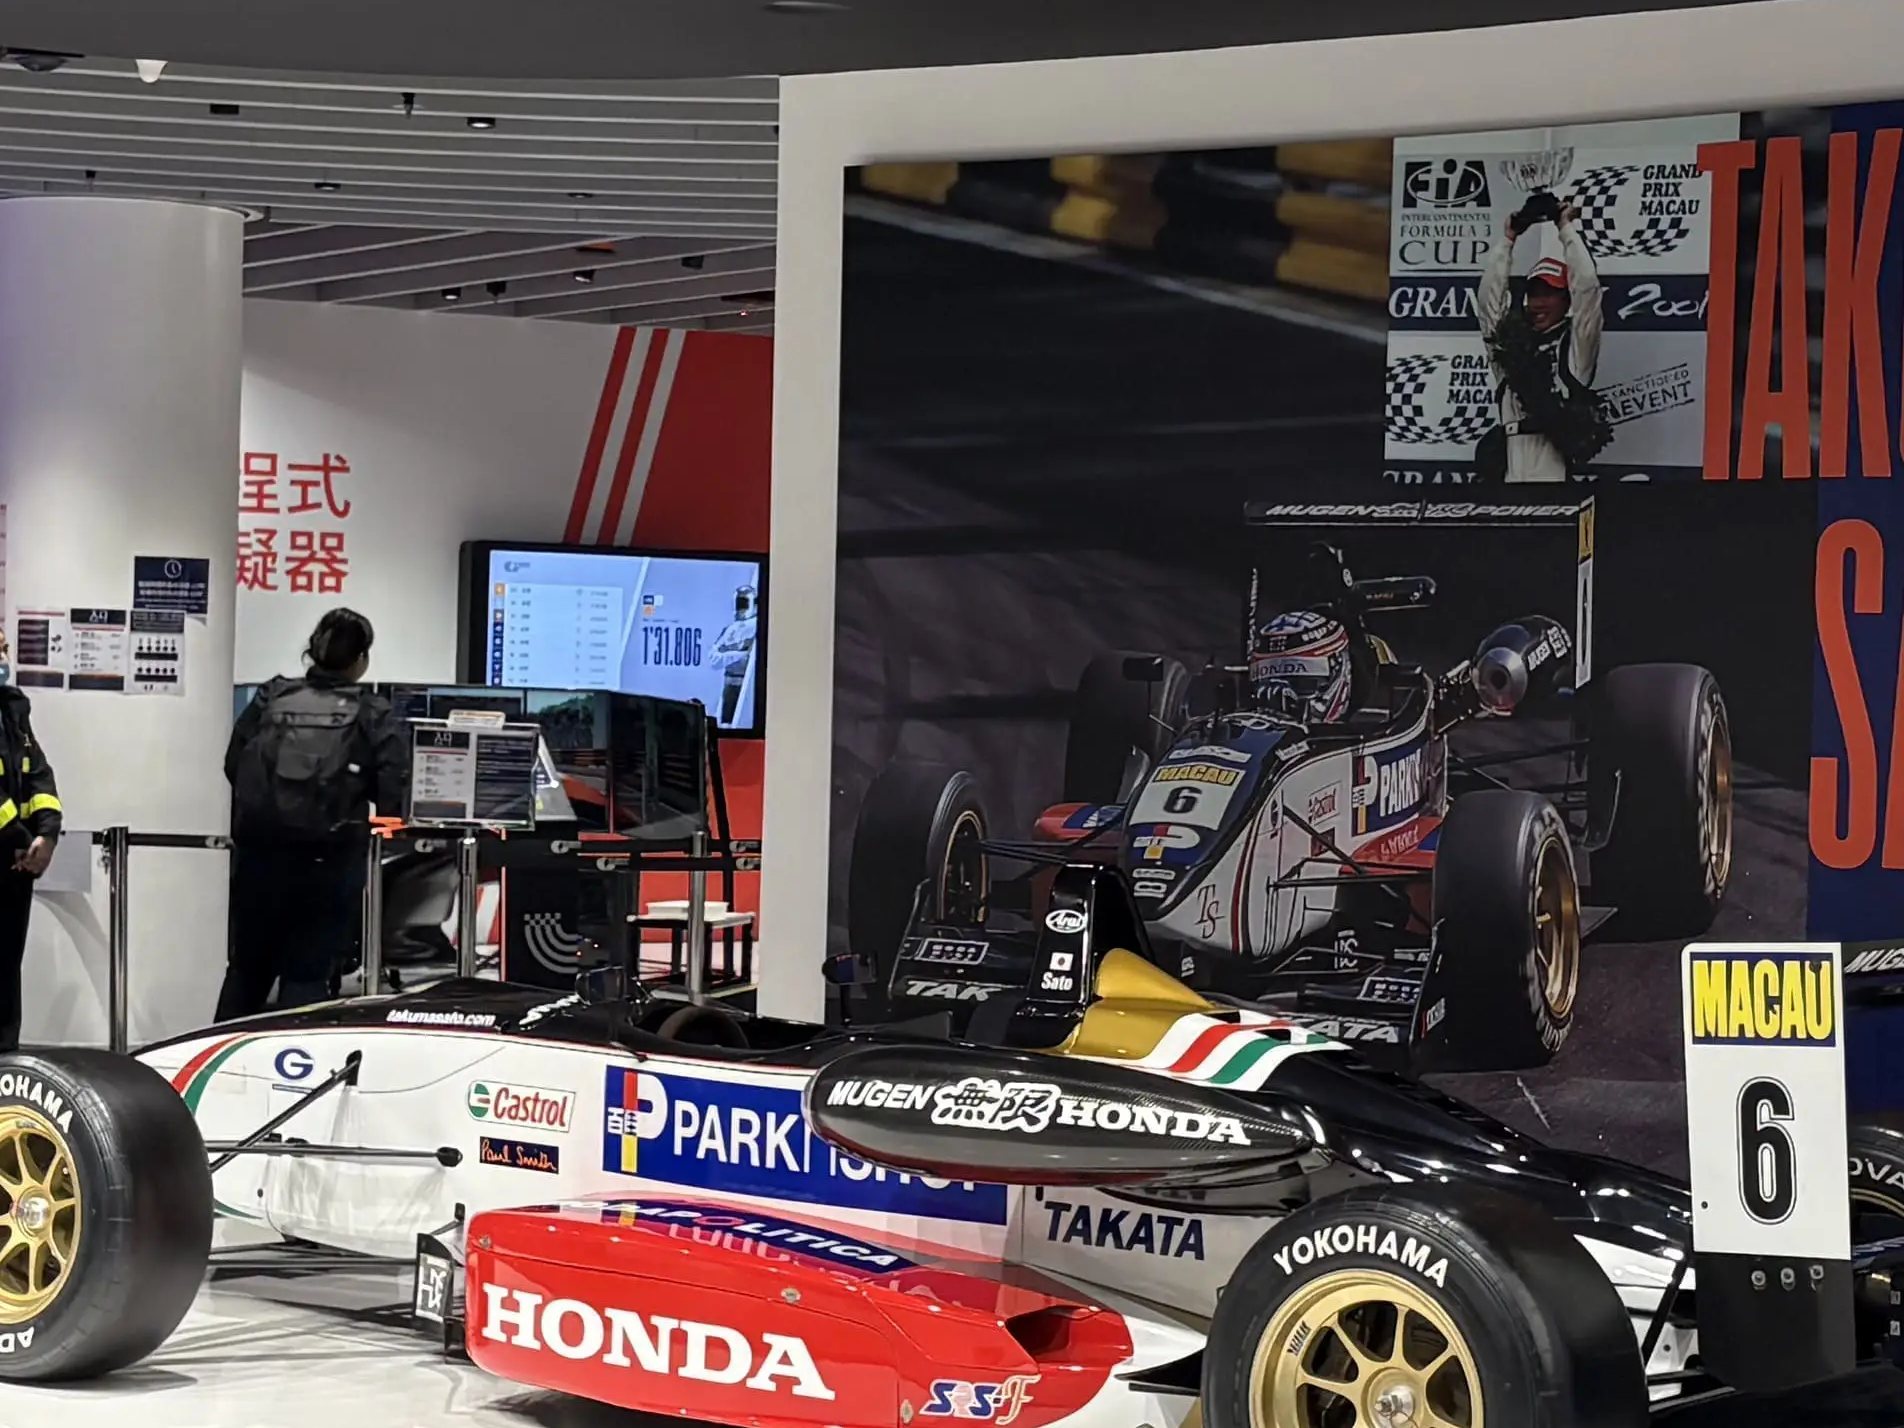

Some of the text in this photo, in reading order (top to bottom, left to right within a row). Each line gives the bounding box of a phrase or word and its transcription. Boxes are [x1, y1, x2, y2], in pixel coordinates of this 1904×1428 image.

[1643, 163, 1703, 180] GRAND
[1641, 182, 1682, 197] PRIX
[1639, 200, 1700, 216] MACAU
[1399, 224, 1477, 239] FORMULA
[1398, 240, 1491, 265] CUP
[1450, 372, 1488, 387] PRIX
[1622, 380, 1693, 416] EVENT
[1266, 504, 1581, 518] MUGEN POWER
[1156, 765, 1238, 786] MACAU
[1163, 785, 1203, 814] 6
[1041, 972, 1074, 992] Sato
[1693, 959, 1833, 1040] MACAU
[492, 1086, 569, 1128] Castrol
[827, 1079, 937, 1111] MUGEN
[1056, 1095, 1252, 1146] HONDA
[1736, 1076, 1797, 1225] 6
[1044, 1199, 1206, 1262] TAKATA
[1272, 1223, 1450, 1290] YOKOHAMA
[481, 1281, 836, 1402] HONDA
